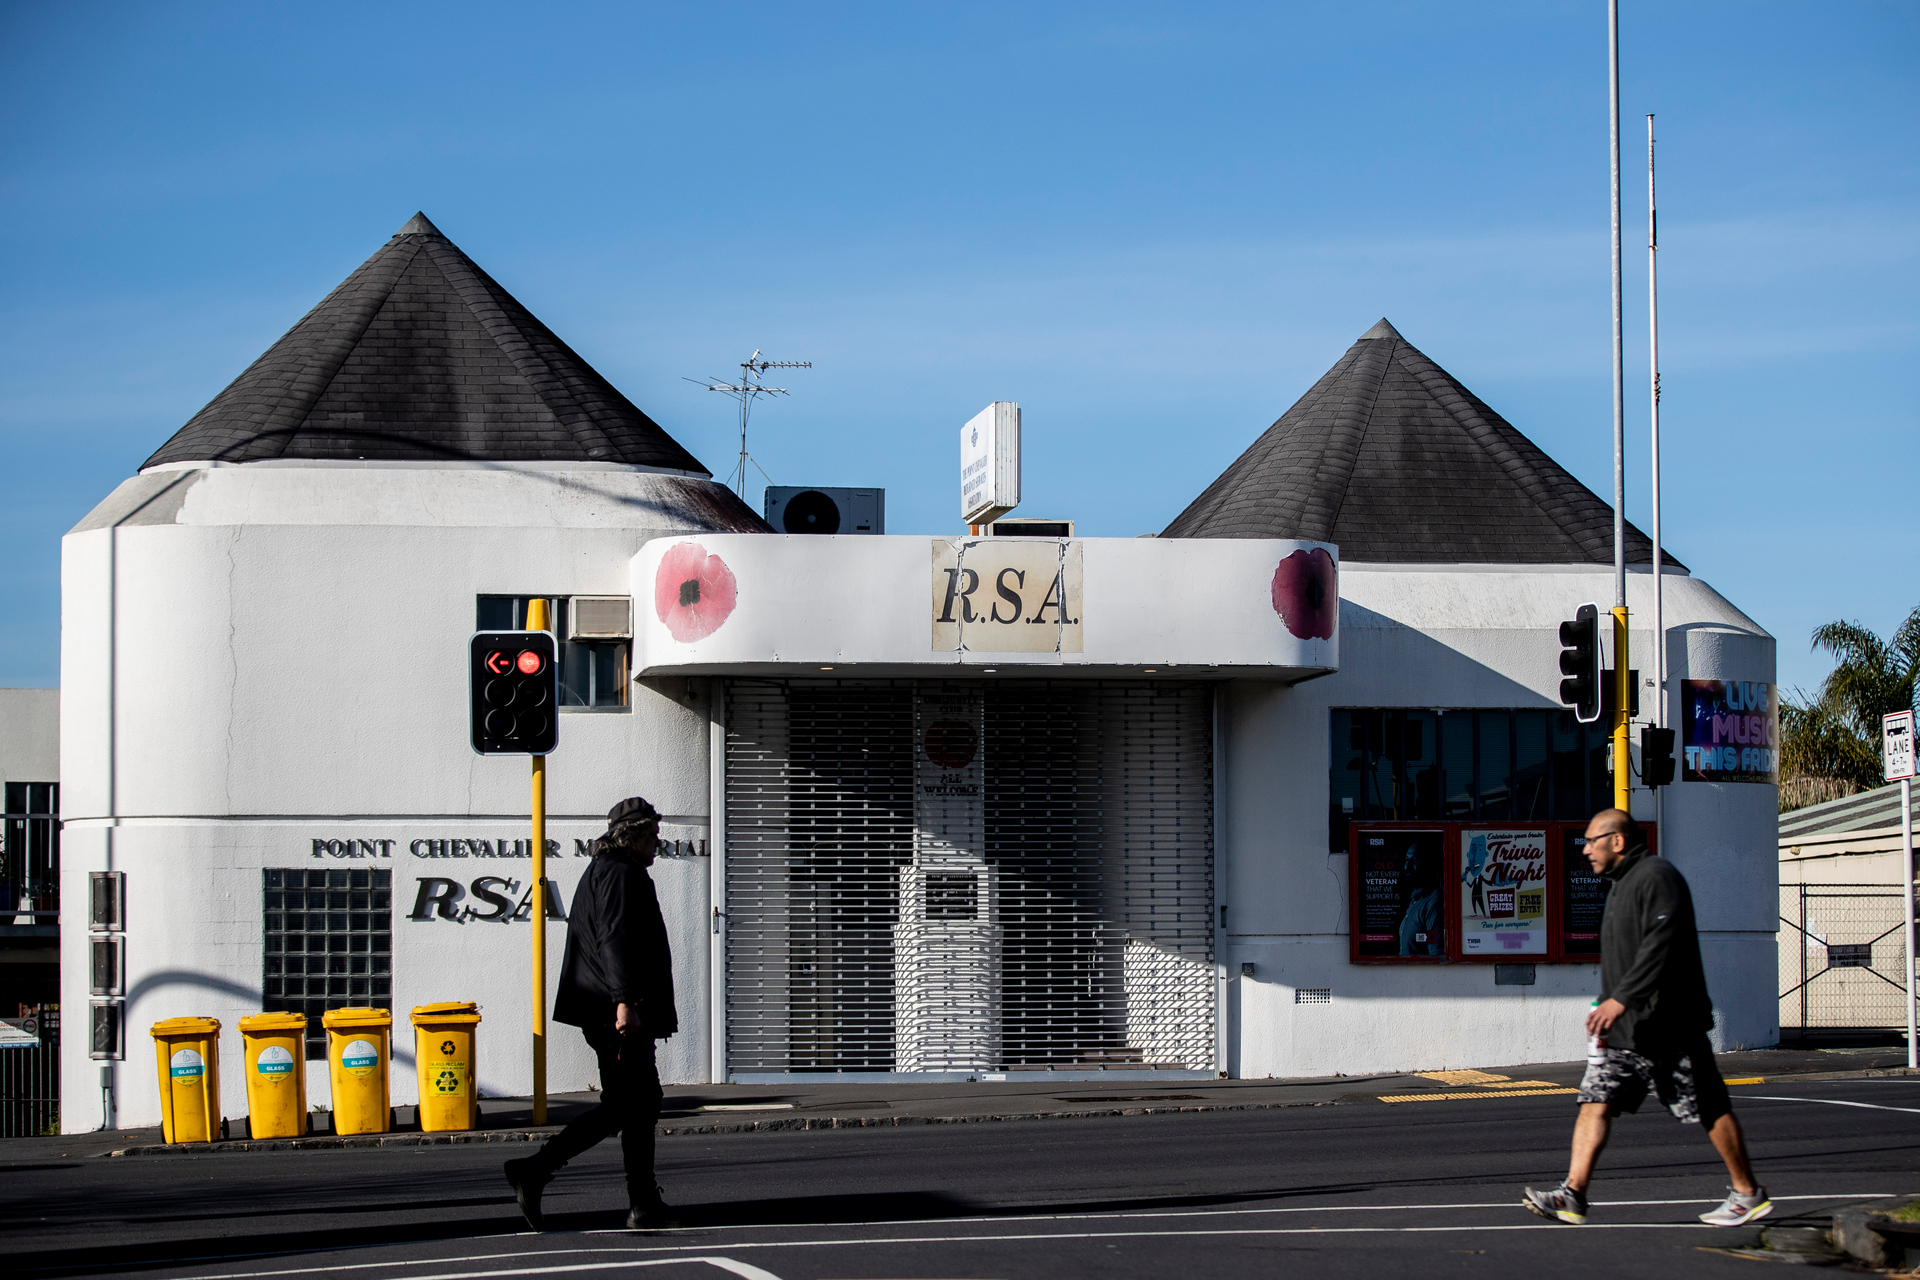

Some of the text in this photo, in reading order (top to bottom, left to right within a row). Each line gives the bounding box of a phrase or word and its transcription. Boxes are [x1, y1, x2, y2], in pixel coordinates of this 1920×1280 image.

[936, 567, 1079, 625] R.S.A.
[1726, 681, 1768, 712] LIVE
[1712, 714, 1774, 746] MUSIC
[1887, 738, 1910, 756] LANE
[1684, 746, 1737, 771] THIS
[940, 774, 962, 784] ALL
[1514, 832, 1527, 841] your
[310, 838, 396, 858] POINT
[1487, 840, 1544, 863] Trivia
[1374, 861, 1394, 870] OLD
[539, 877, 545, 886] 6
[1485, 861, 1546, 890] Night
[1489, 893, 1542, 905] GREAT FREE
[1489, 903, 1541, 914] PRIZES ENTRY
[1481, 920, 1532, 929] Fun for everyone!
